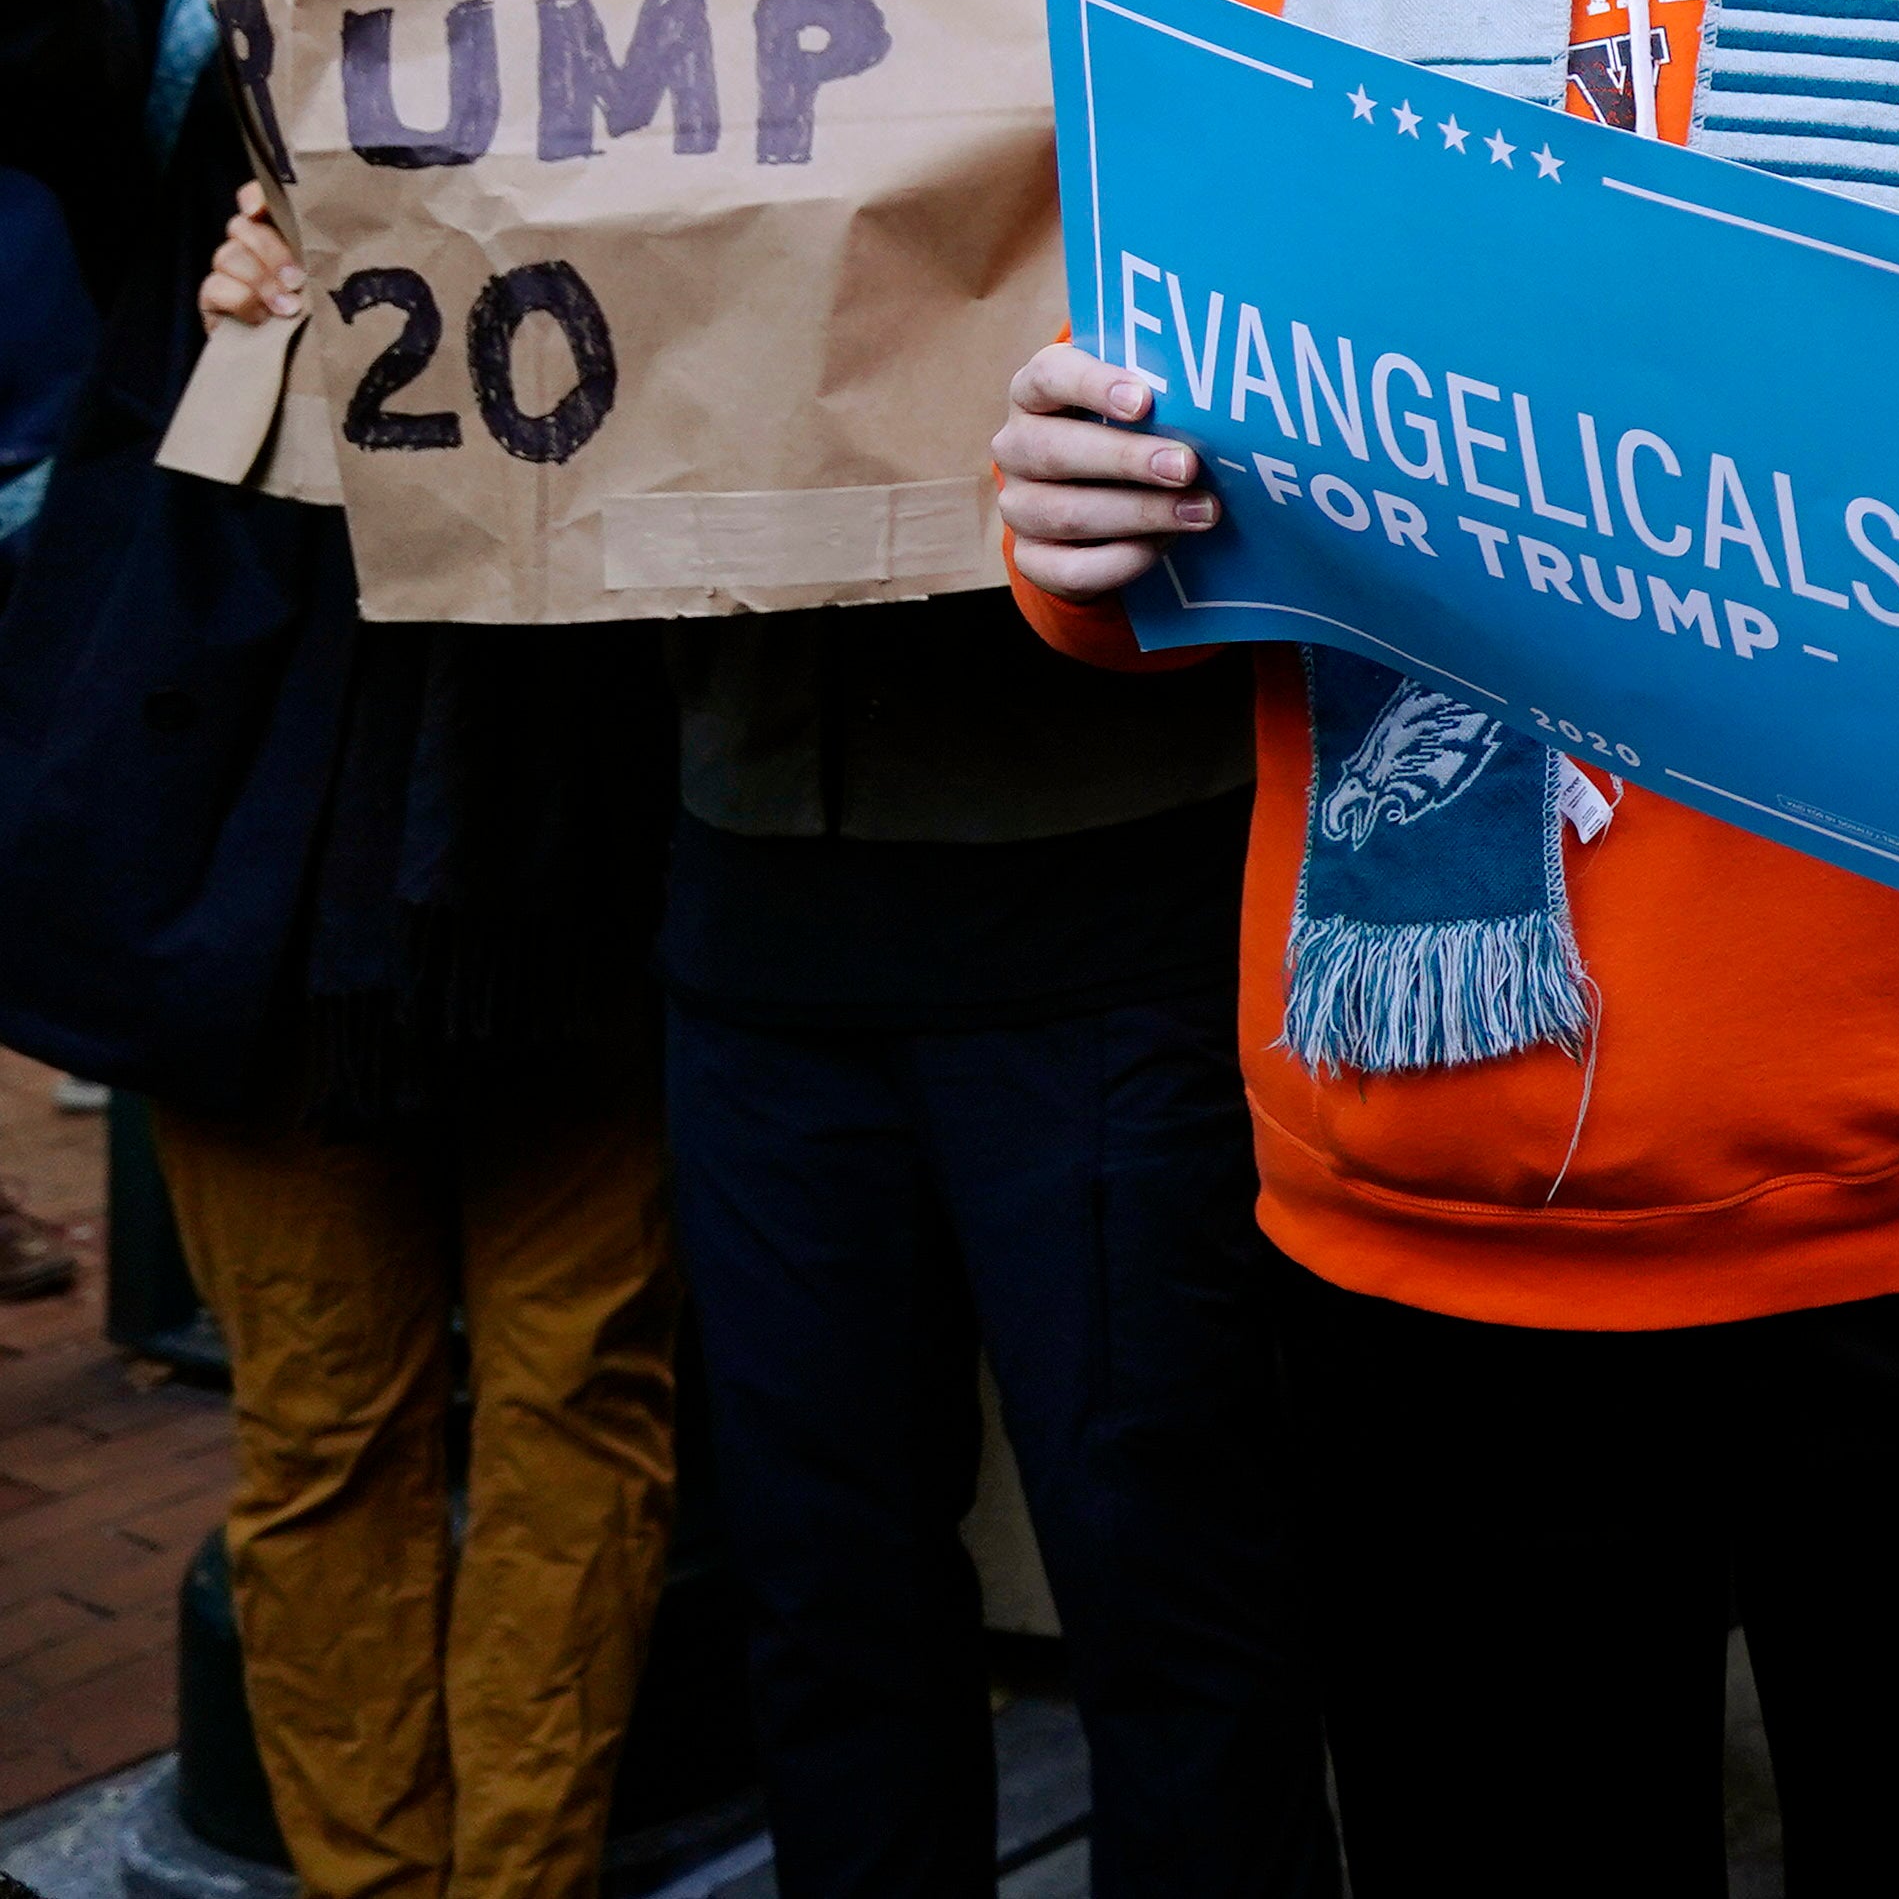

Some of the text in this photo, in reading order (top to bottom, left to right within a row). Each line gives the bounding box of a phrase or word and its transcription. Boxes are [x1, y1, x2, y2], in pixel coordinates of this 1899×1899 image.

[327, 259, 619, 465] 20
[1251, 451, 1780, 660] FOR TRUMP
[1529, 707, 1641, 767] 2020
